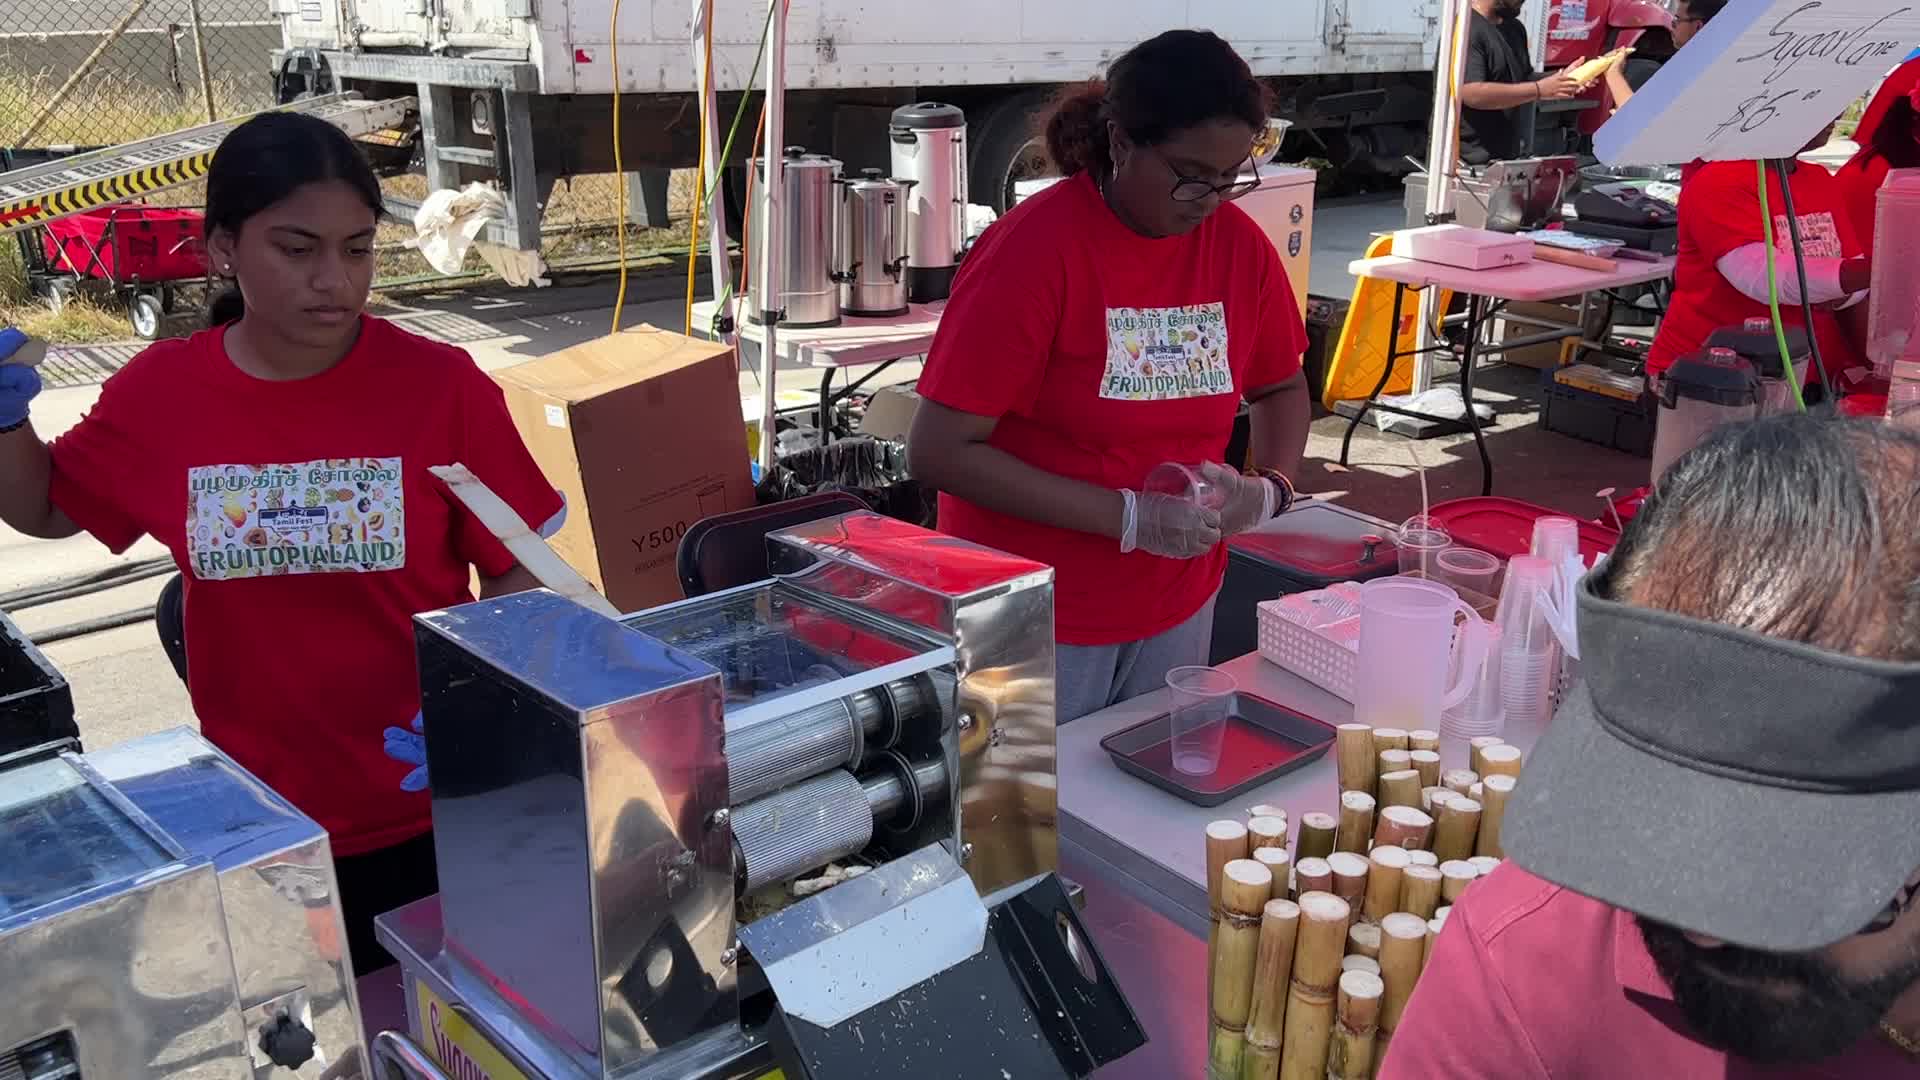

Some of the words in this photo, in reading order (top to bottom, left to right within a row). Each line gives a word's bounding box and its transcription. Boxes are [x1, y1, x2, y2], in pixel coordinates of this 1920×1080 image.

[1108, 370, 1227, 393] FRUITOPIALAND
[631, 520, 688, 553] Y500
[198, 541, 396, 571] FRUITOPIALAND
